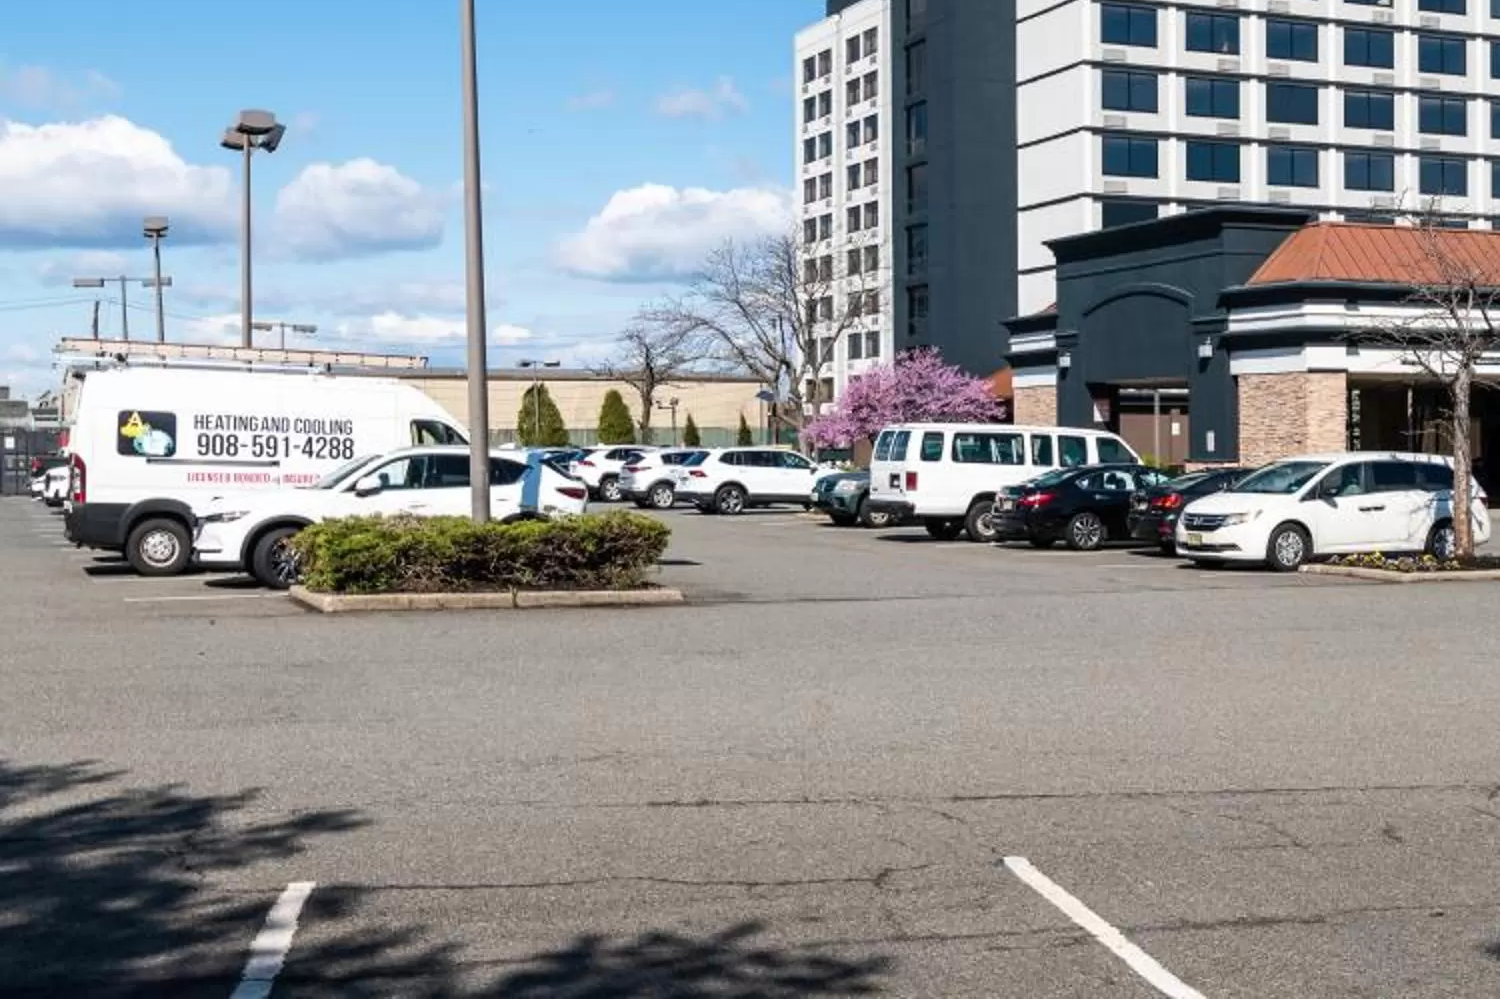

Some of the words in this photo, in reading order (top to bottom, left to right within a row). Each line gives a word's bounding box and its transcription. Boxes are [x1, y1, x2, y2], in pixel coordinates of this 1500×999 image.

[193, 414, 259, 432] HEATING
[260, 416, 290, 433] AND
[294, 418, 353, 435] COOLING
[197, 433, 354, 460] 908-591-4288
